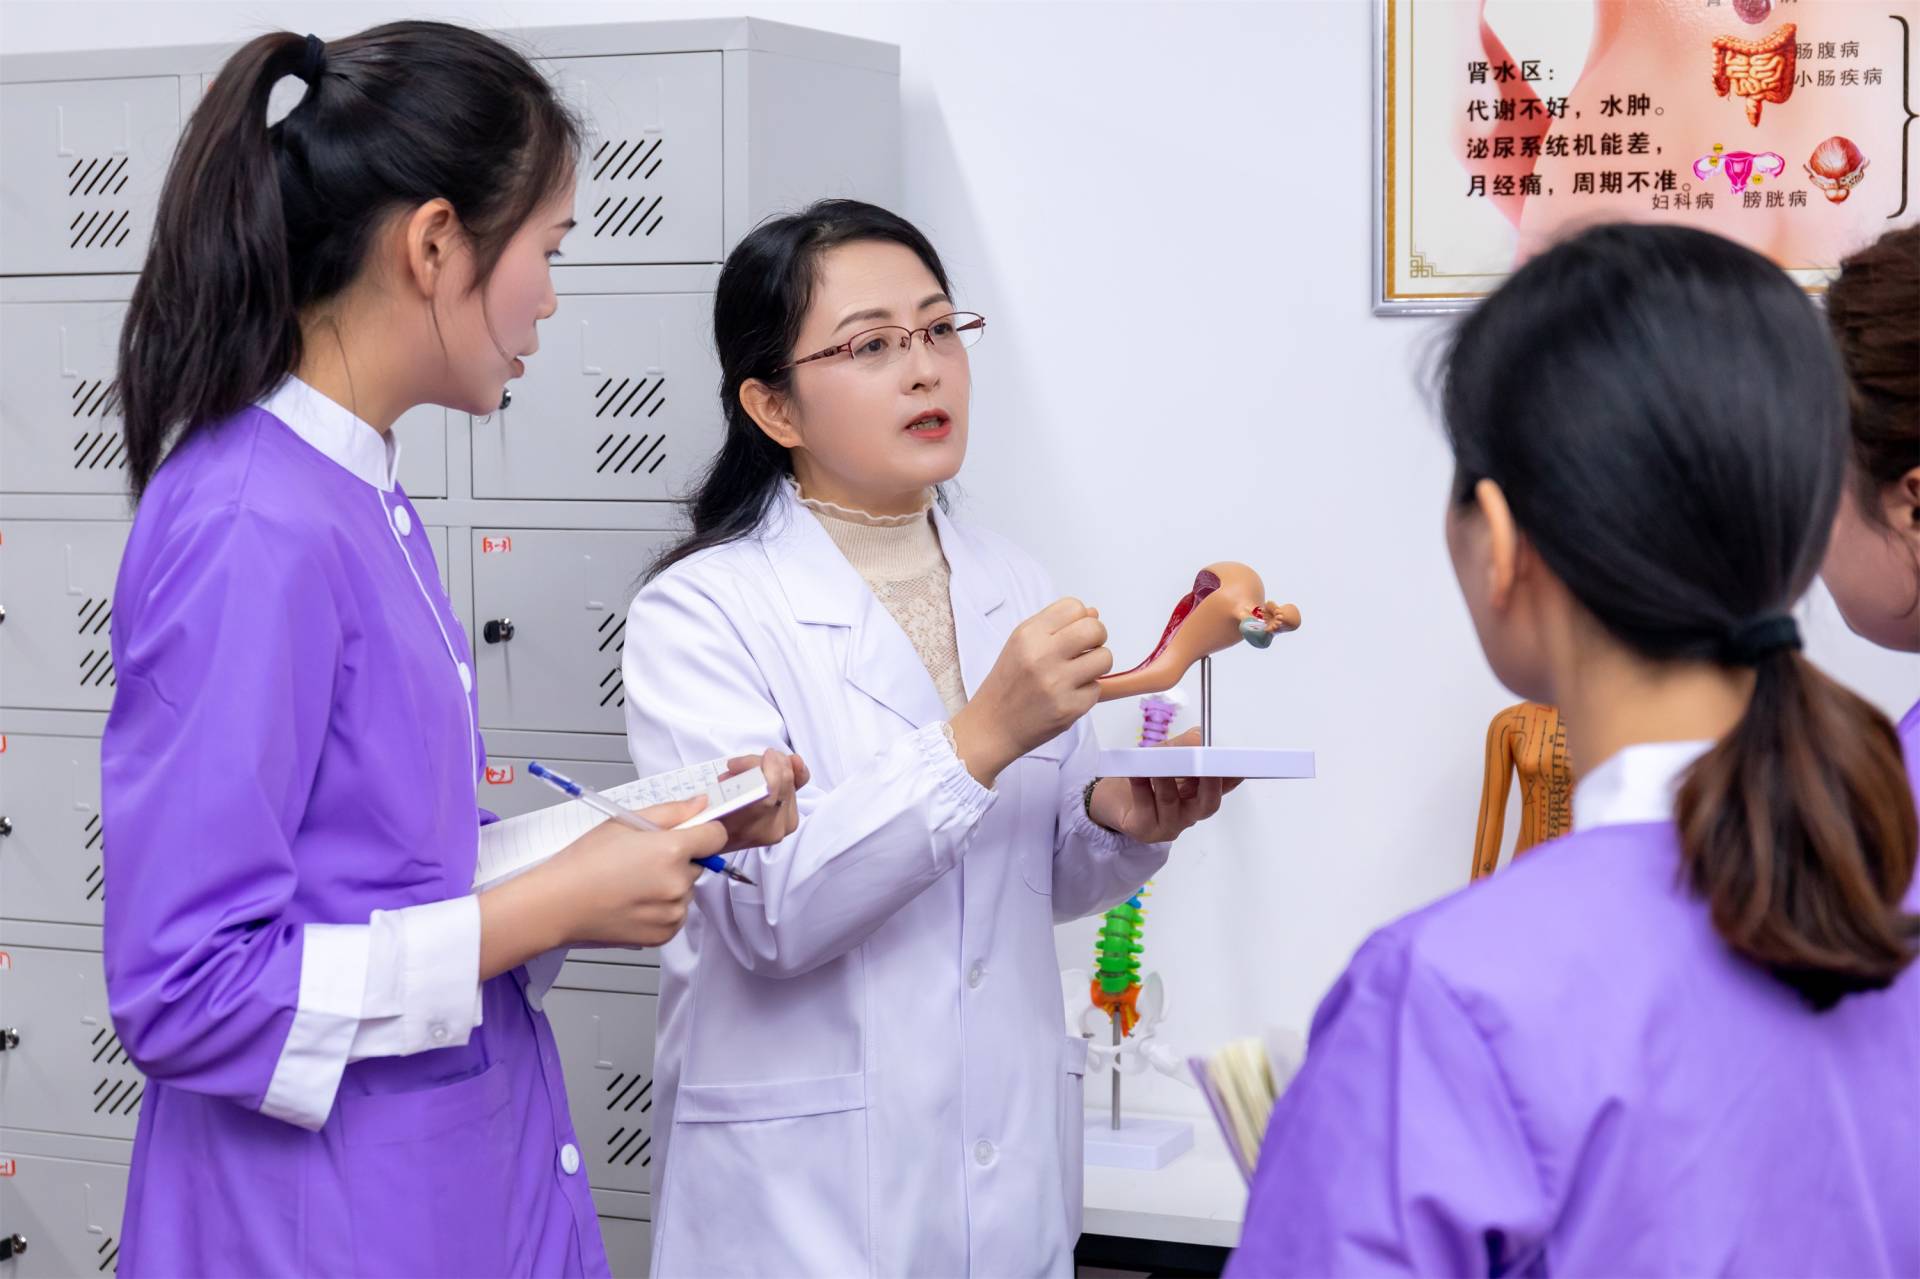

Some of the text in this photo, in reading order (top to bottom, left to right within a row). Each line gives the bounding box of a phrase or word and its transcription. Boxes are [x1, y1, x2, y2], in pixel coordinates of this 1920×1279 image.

[1795, 67, 1882, 88] 小肠疾病
[1652, 191, 1714, 210] 妇科病
[1743, 189, 1808, 209] 膀胱病
